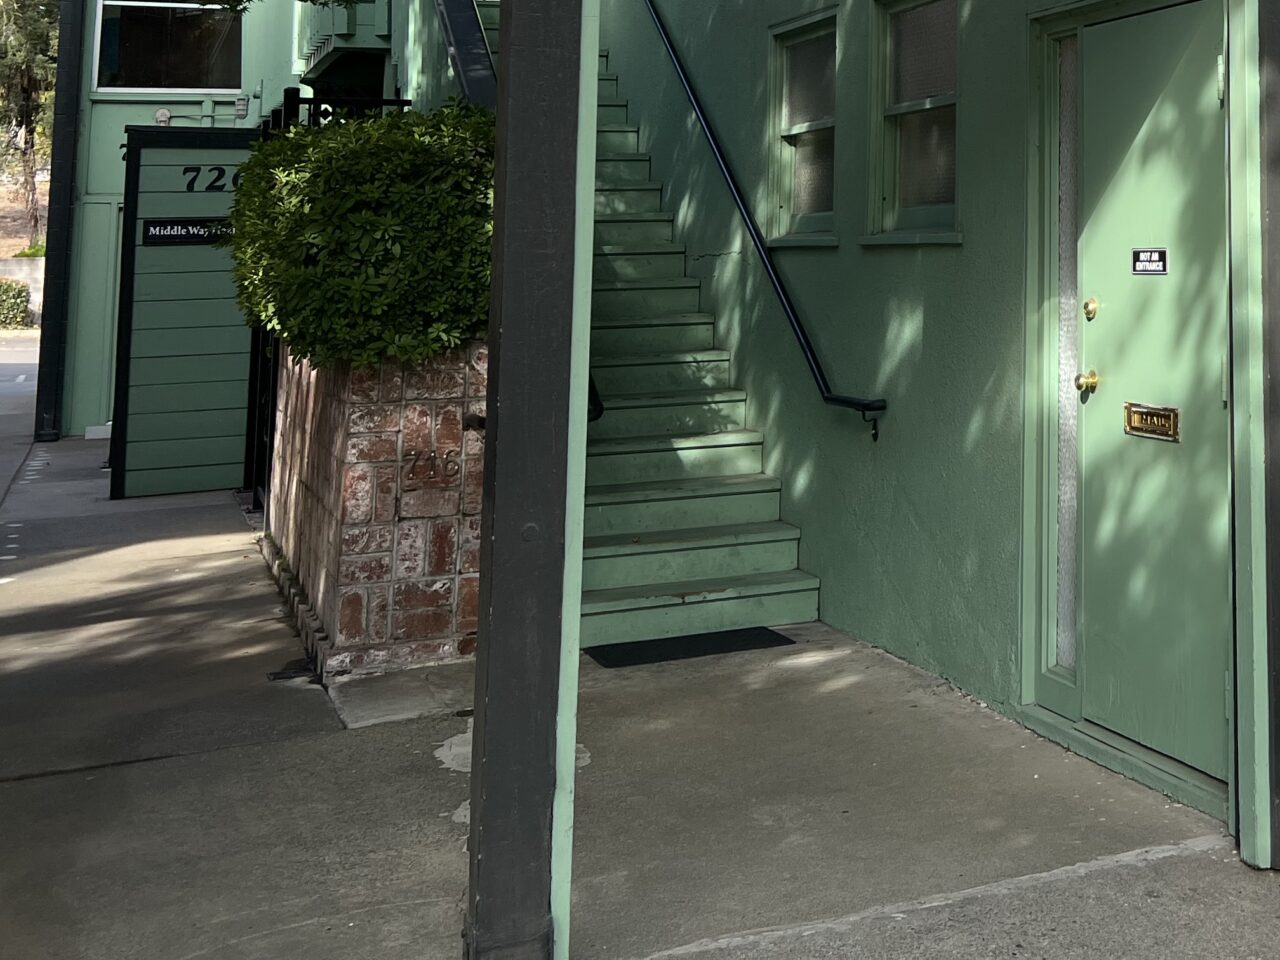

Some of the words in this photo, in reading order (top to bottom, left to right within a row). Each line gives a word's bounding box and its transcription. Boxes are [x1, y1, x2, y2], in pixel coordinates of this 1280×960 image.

[149, 225, 187, 235] Middle
[188, 226, 209, 237] Way
[1139, 252, 1150, 261] NOT
[1151, 252, 1159, 261] AN
[1135, 261, 1163, 271] ENTRANCE
[1142, 414, 1168, 428] MAIL
[401, 449, 460, 480] 716
